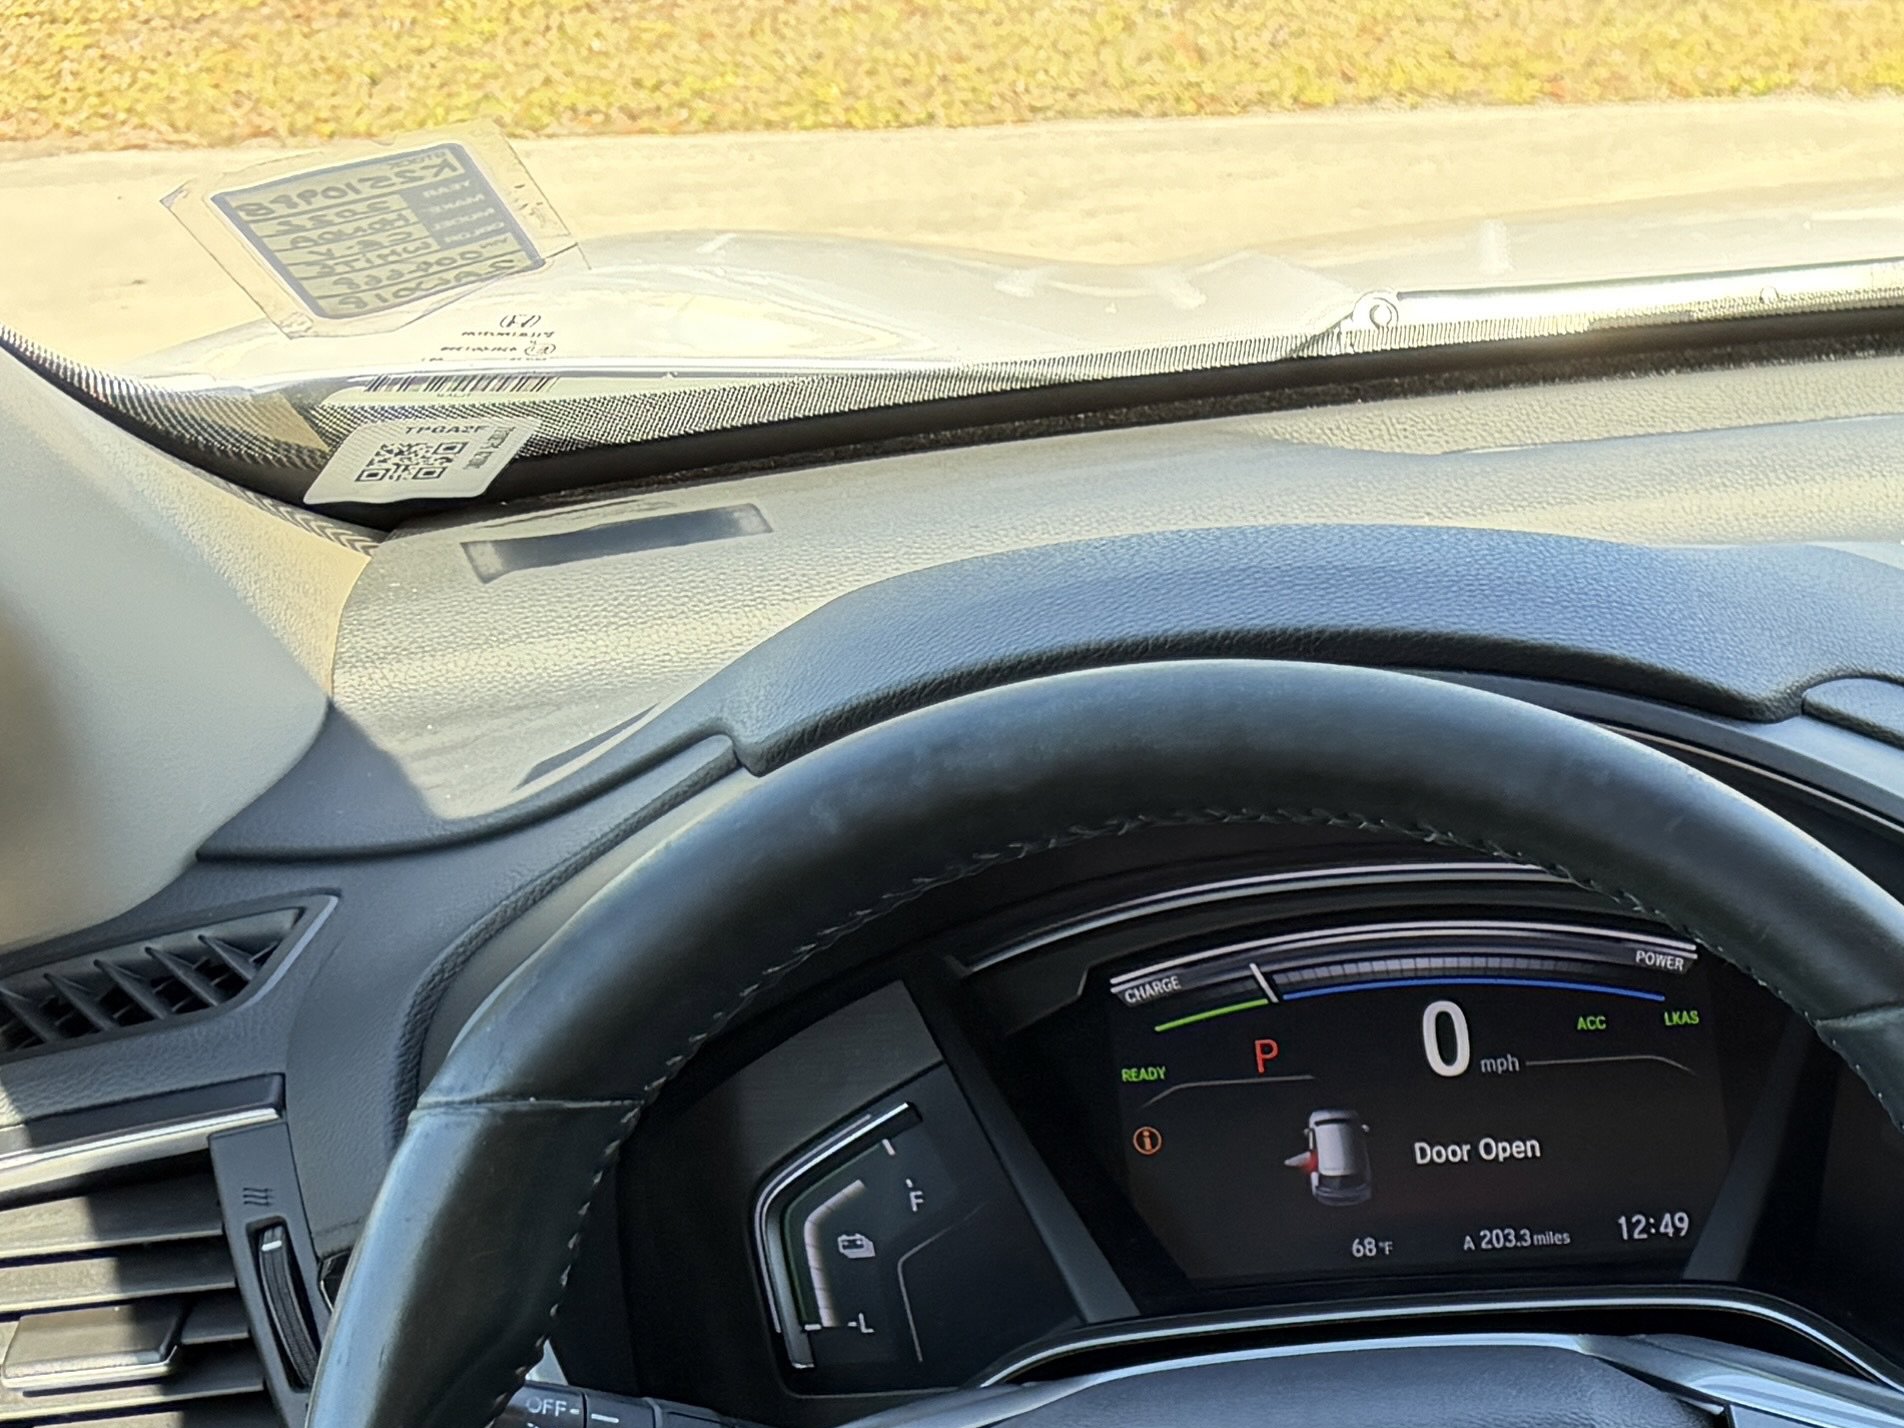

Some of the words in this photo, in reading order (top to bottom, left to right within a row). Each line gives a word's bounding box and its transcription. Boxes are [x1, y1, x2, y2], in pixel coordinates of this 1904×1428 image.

[1635, 950, 1685, 972] POWER
[1124, 975, 1182, 1004] CHARGE
[1577, 1016, 1607, 1031] ACC
[1664, 1011, 1699, 1026] LKAS
[1422, 1000, 1470, 1077] 0
[1480, 1054, 1520, 1075] mph
[1254, 1039, 1280, 1073] P
[1121, 1066, 1166, 1082] READY
[1414, 1141, 1471, 1165] Door
[1478, 1137, 1541, 1162] Open
[909, 1190, 924, 1212] F
[1617, 1211, 1690, 1241] 12:49
[1463, 1235, 1475, 1251] A
[526, 1399, 567, 1417] OFF
